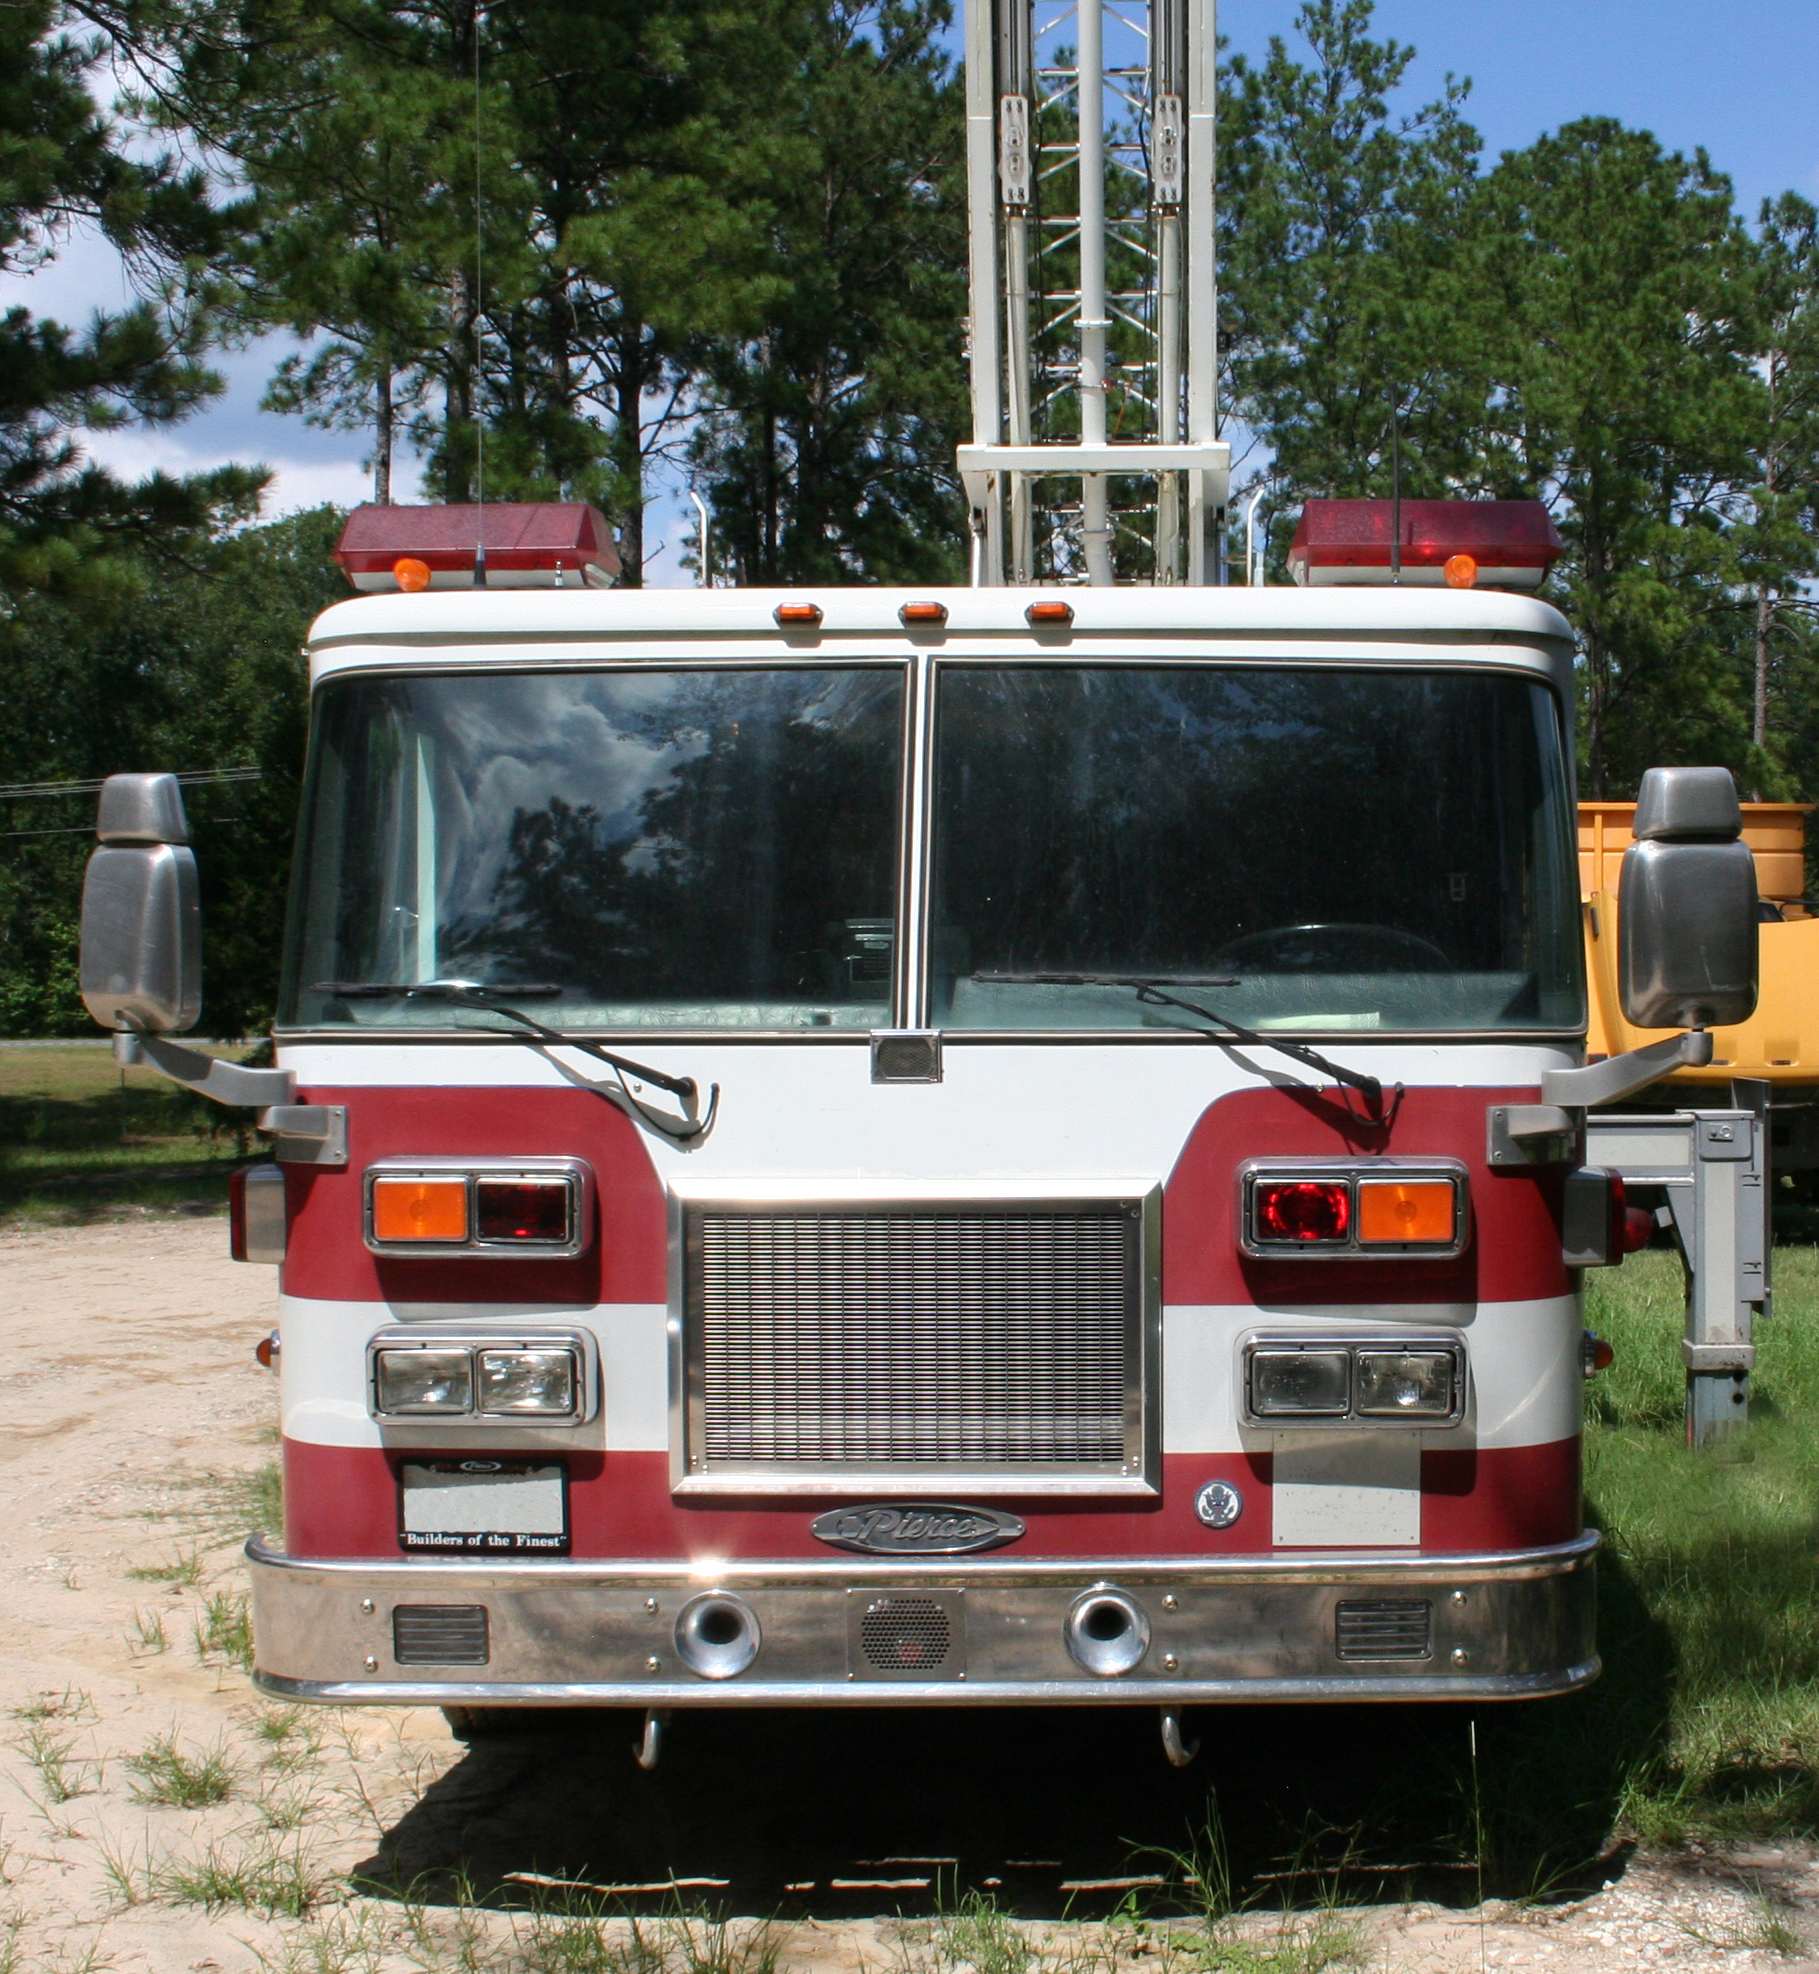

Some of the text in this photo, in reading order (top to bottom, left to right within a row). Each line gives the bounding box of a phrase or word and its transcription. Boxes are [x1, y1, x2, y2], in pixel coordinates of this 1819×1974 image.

[859, 1509, 974, 1541] Pierce
[468, 1533, 482, 1545] of
[488, 1534, 510, 1546] the
